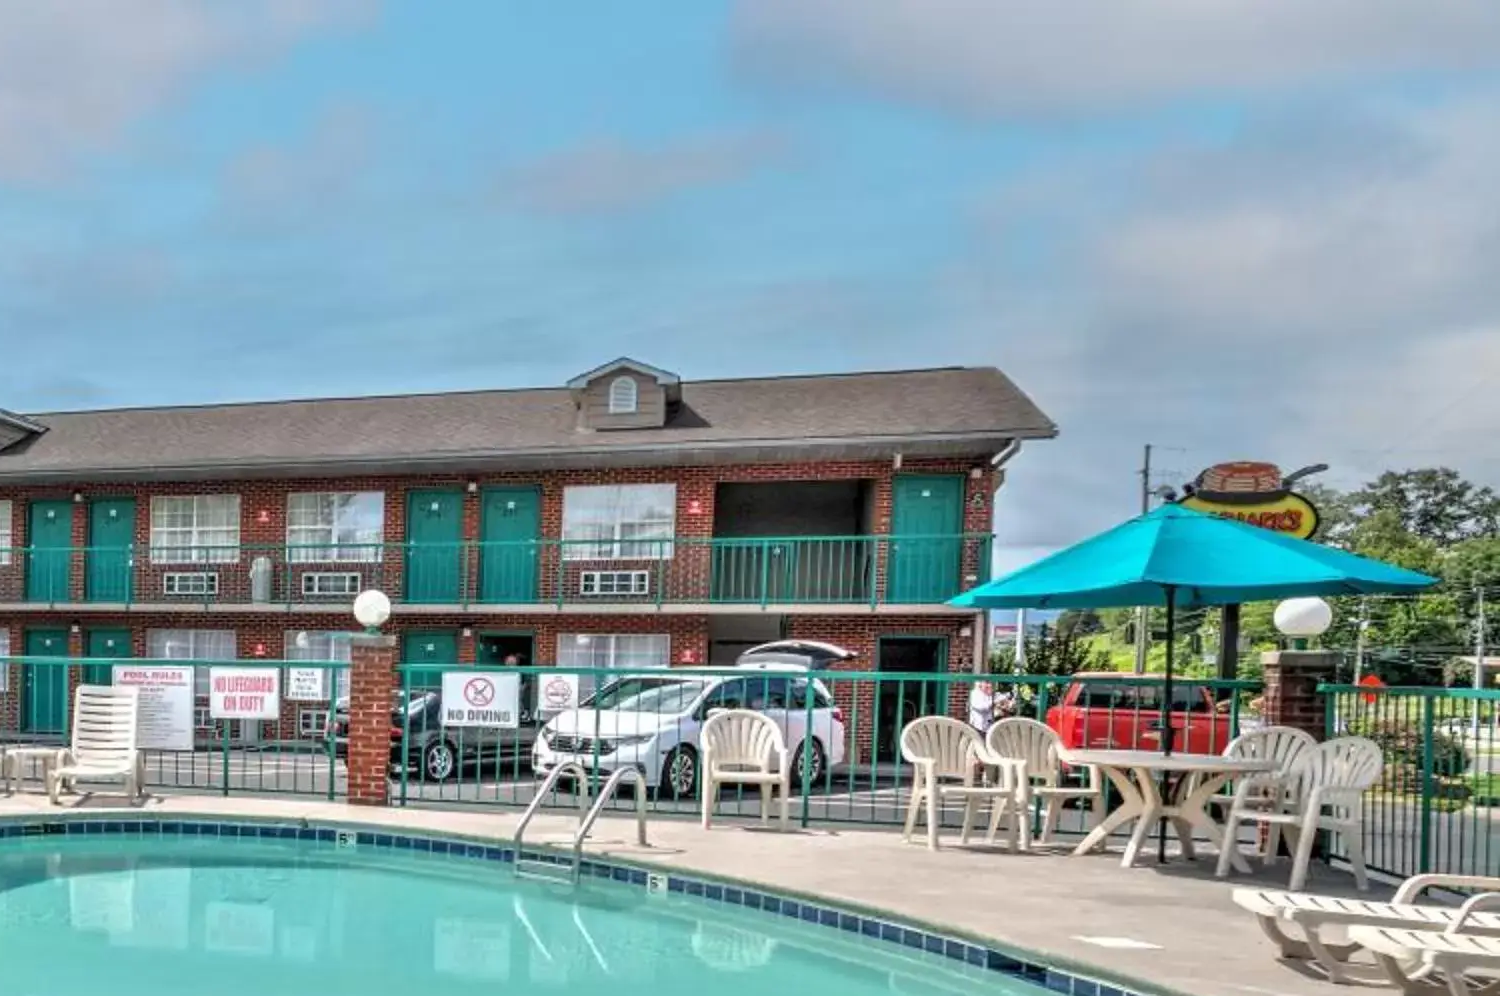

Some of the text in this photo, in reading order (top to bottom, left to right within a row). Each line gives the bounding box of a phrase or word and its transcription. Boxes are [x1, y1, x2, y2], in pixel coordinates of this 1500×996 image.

[123, 671, 149, 680] POOL
[214, 676, 274, 693] NO LIFEGUARD
[224, 696, 265, 712] ON DUTY
[447, 708, 510, 723] NO DIVING
